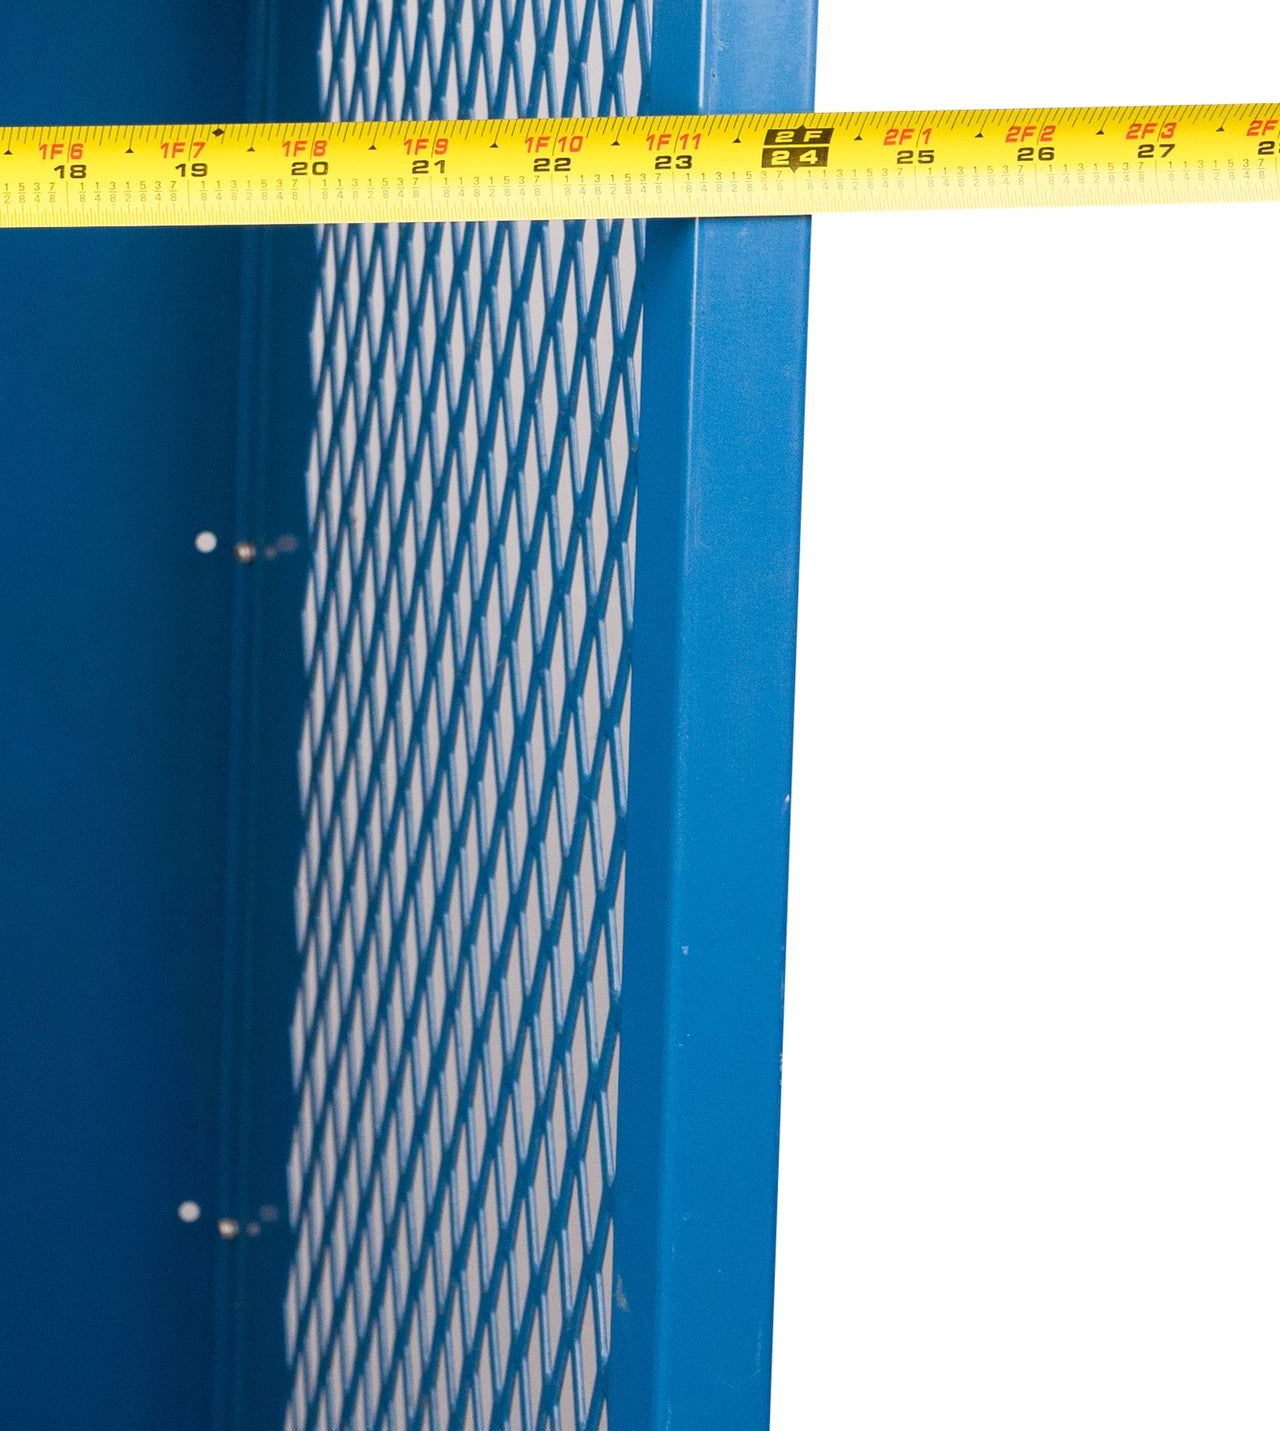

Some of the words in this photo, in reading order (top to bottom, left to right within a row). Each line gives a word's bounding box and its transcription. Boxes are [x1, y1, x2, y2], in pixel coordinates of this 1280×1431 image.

[558, 136, 583, 152] 10
[679, 133, 702, 150] 11
[1258, 140, 1280, 155] 2
[771, 150, 818, 165] 24
[896, 150, 935, 164] 25
[1017, 147, 1055, 161] 26
[1137, 144, 1175, 158] 27
[291, 162, 328, 176] 20
[412, 160, 446, 174] 21
[533, 157, 572, 172] 22
[654, 155, 692, 170] 23
[53, 165, 87, 179] 18
[175, 163, 208, 177] 19
